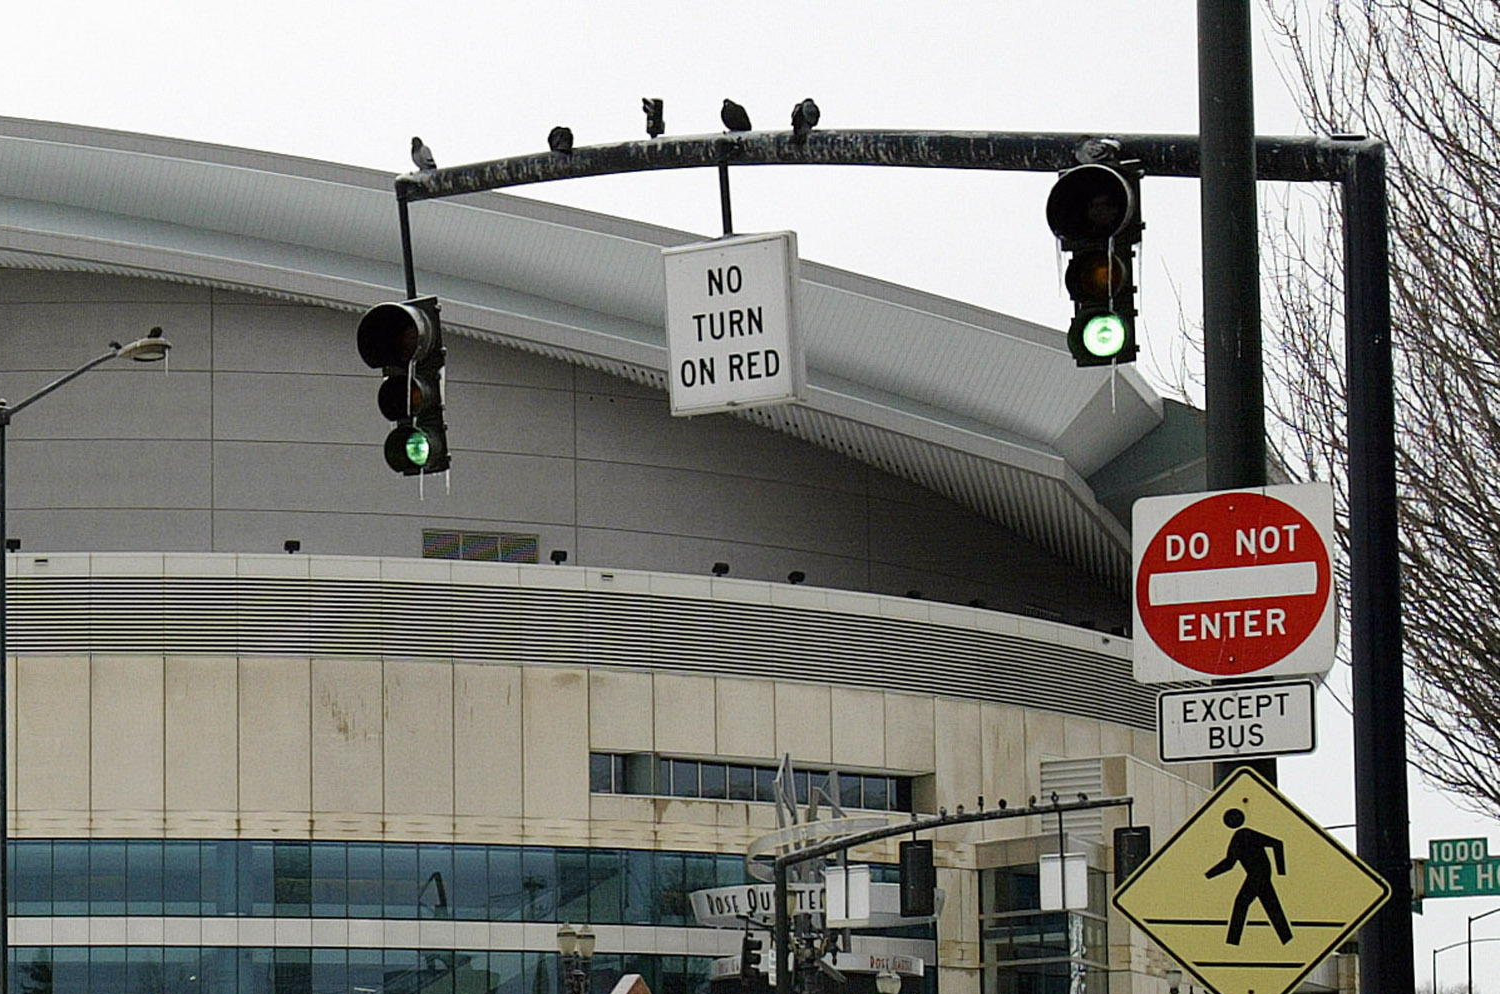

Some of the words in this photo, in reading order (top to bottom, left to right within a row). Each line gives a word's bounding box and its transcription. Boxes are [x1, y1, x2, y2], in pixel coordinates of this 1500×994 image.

[707, 265, 742, 296] NO
[692, 306, 763, 342] TURN
[680, 357, 716, 388] ON
[729, 349, 780, 382] RED
[1165, 532, 1209, 562] DO
[1236, 524, 1301, 556] NOT
[1178, 608, 1287, 642] ENTER
[1182, 693, 1290, 723] EXCEPT
[1209, 723, 1264, 749] BUS
[1432, 841, 1484, 862] 1000
[1429, 864, 1464, 891] NE
[1476, 863, 1500, 890] H
